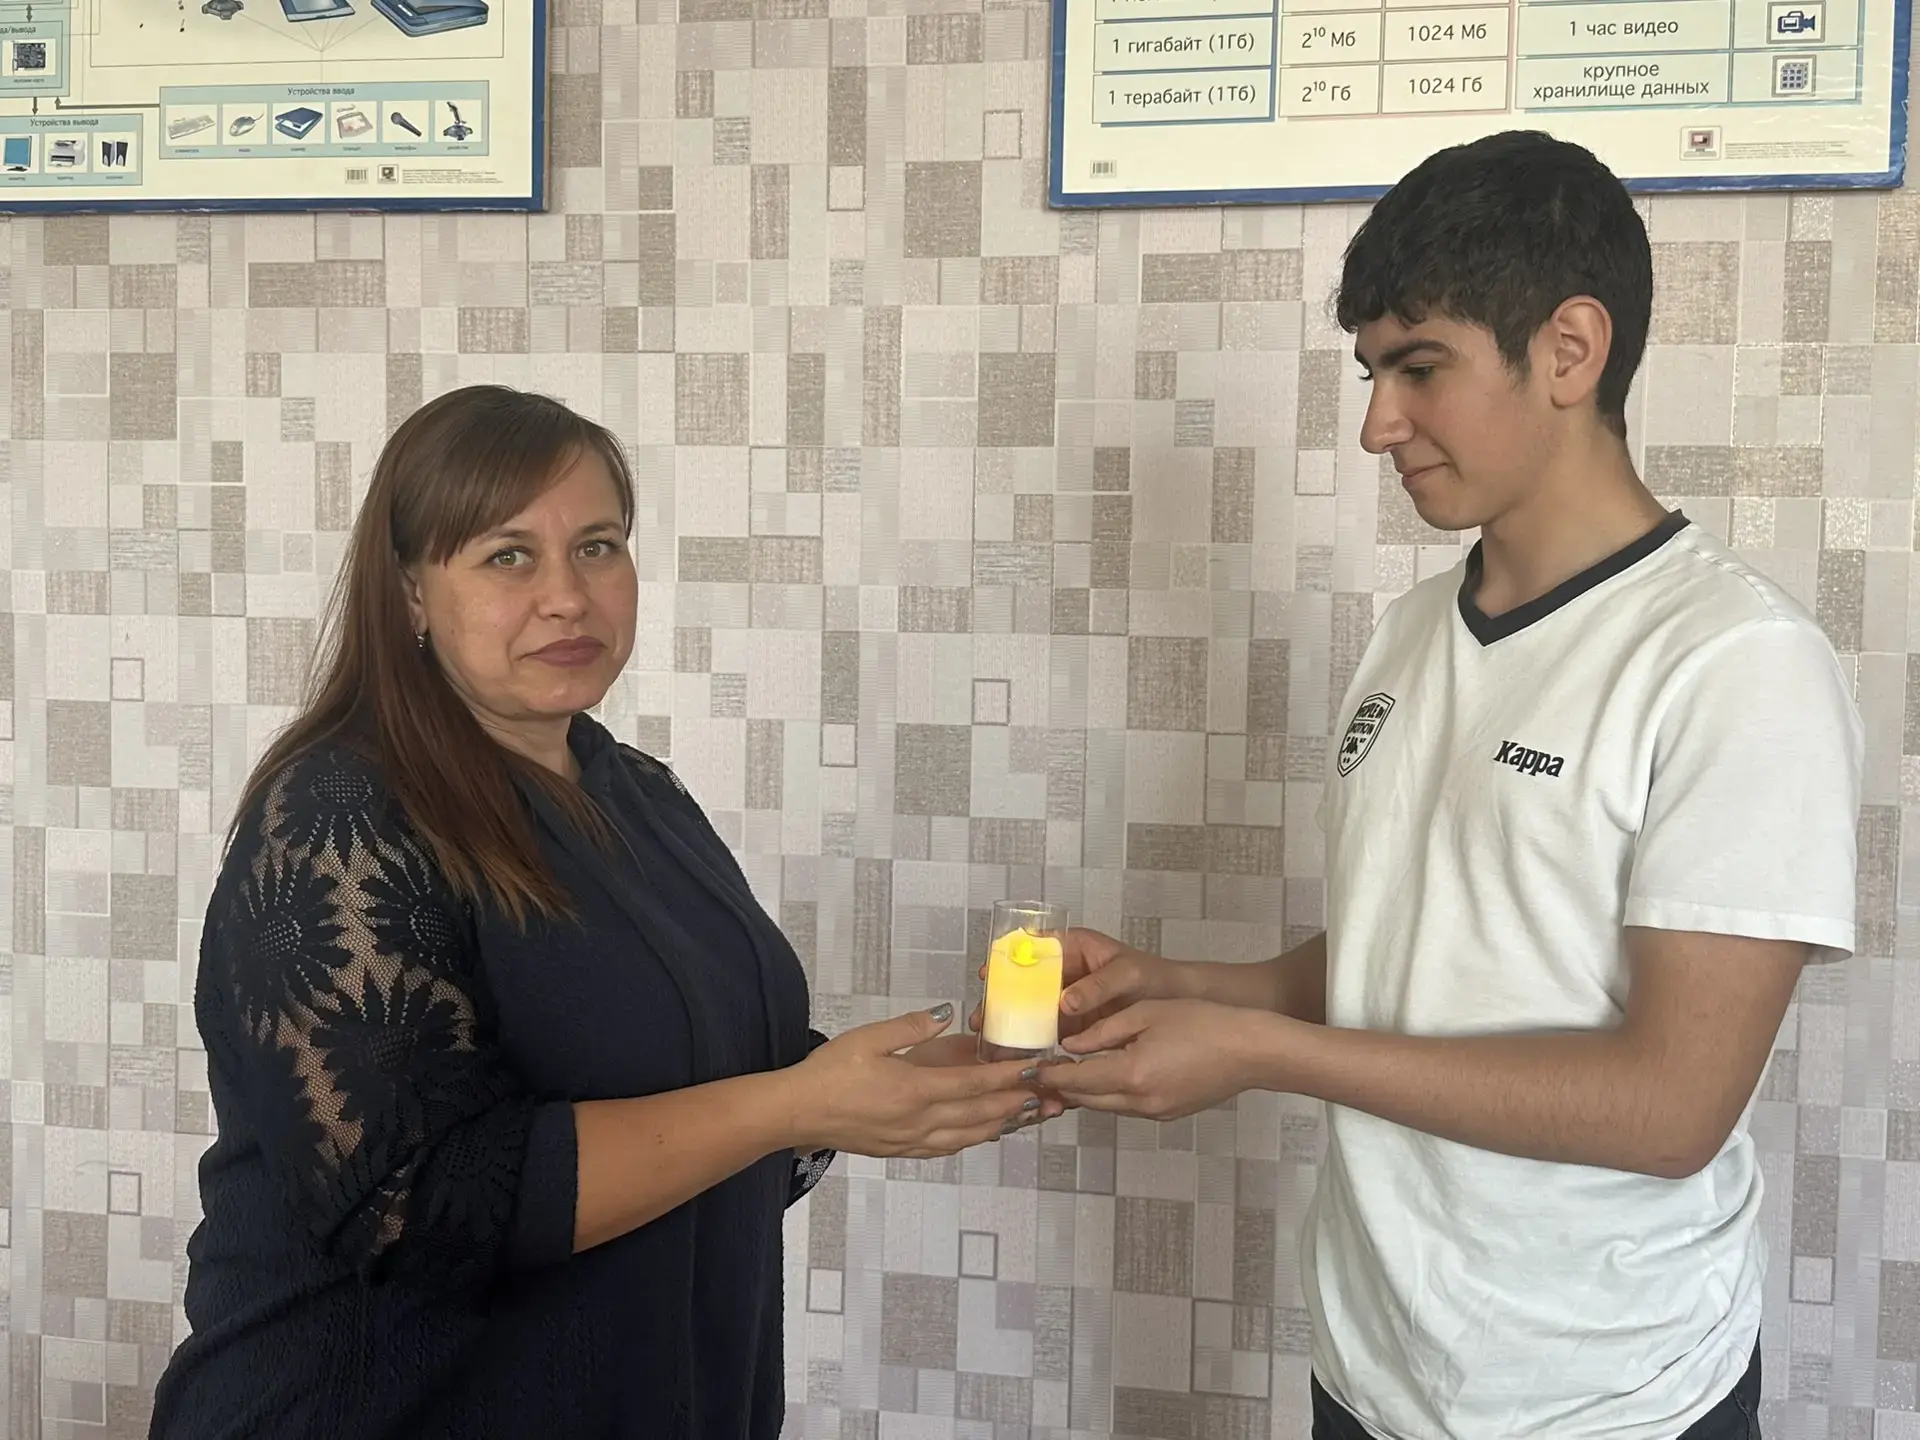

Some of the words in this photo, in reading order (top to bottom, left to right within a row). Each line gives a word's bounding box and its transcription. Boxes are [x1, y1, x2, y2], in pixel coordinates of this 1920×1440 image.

[1409, 25, 1454, 41] 1024
[1461, 23, 1487, 40] Мб
[1570, 21, 1576, 36] 1
[1586, 23, 1617, 36] час
[1624, 21, 1678, 38] видео
[1113, 39, 1119, 53] 1
[1129, 35, 1202, 54] гигабайт
[1208, 33, 1255, 53] (1Гб)
[1331, 30, 1356, 48] Мб
[1583, 63, 1660, 81] крупное
[288, 87, 330, 97] Устройства
[333, 87, 354, 96] ввода
[1332, 84, 1351, 102] Гб
[1409, 78, 1455, 95] 1024
[1462, 76, 1483, 93] Гб
[1532, 81, 1635, 101] хранилище
[1640, 80, 1710, 98] данных
[1109, 91, 1115, 105] 1
[1124, 88, 1202, 108] терабайт
[1208, 85, 1256, 105] (1Тб)
[30, 119, 71, 127] Устройства
[73, 118, 99, 127] вывода
[1493, 740, 1565, 778] Kappa
